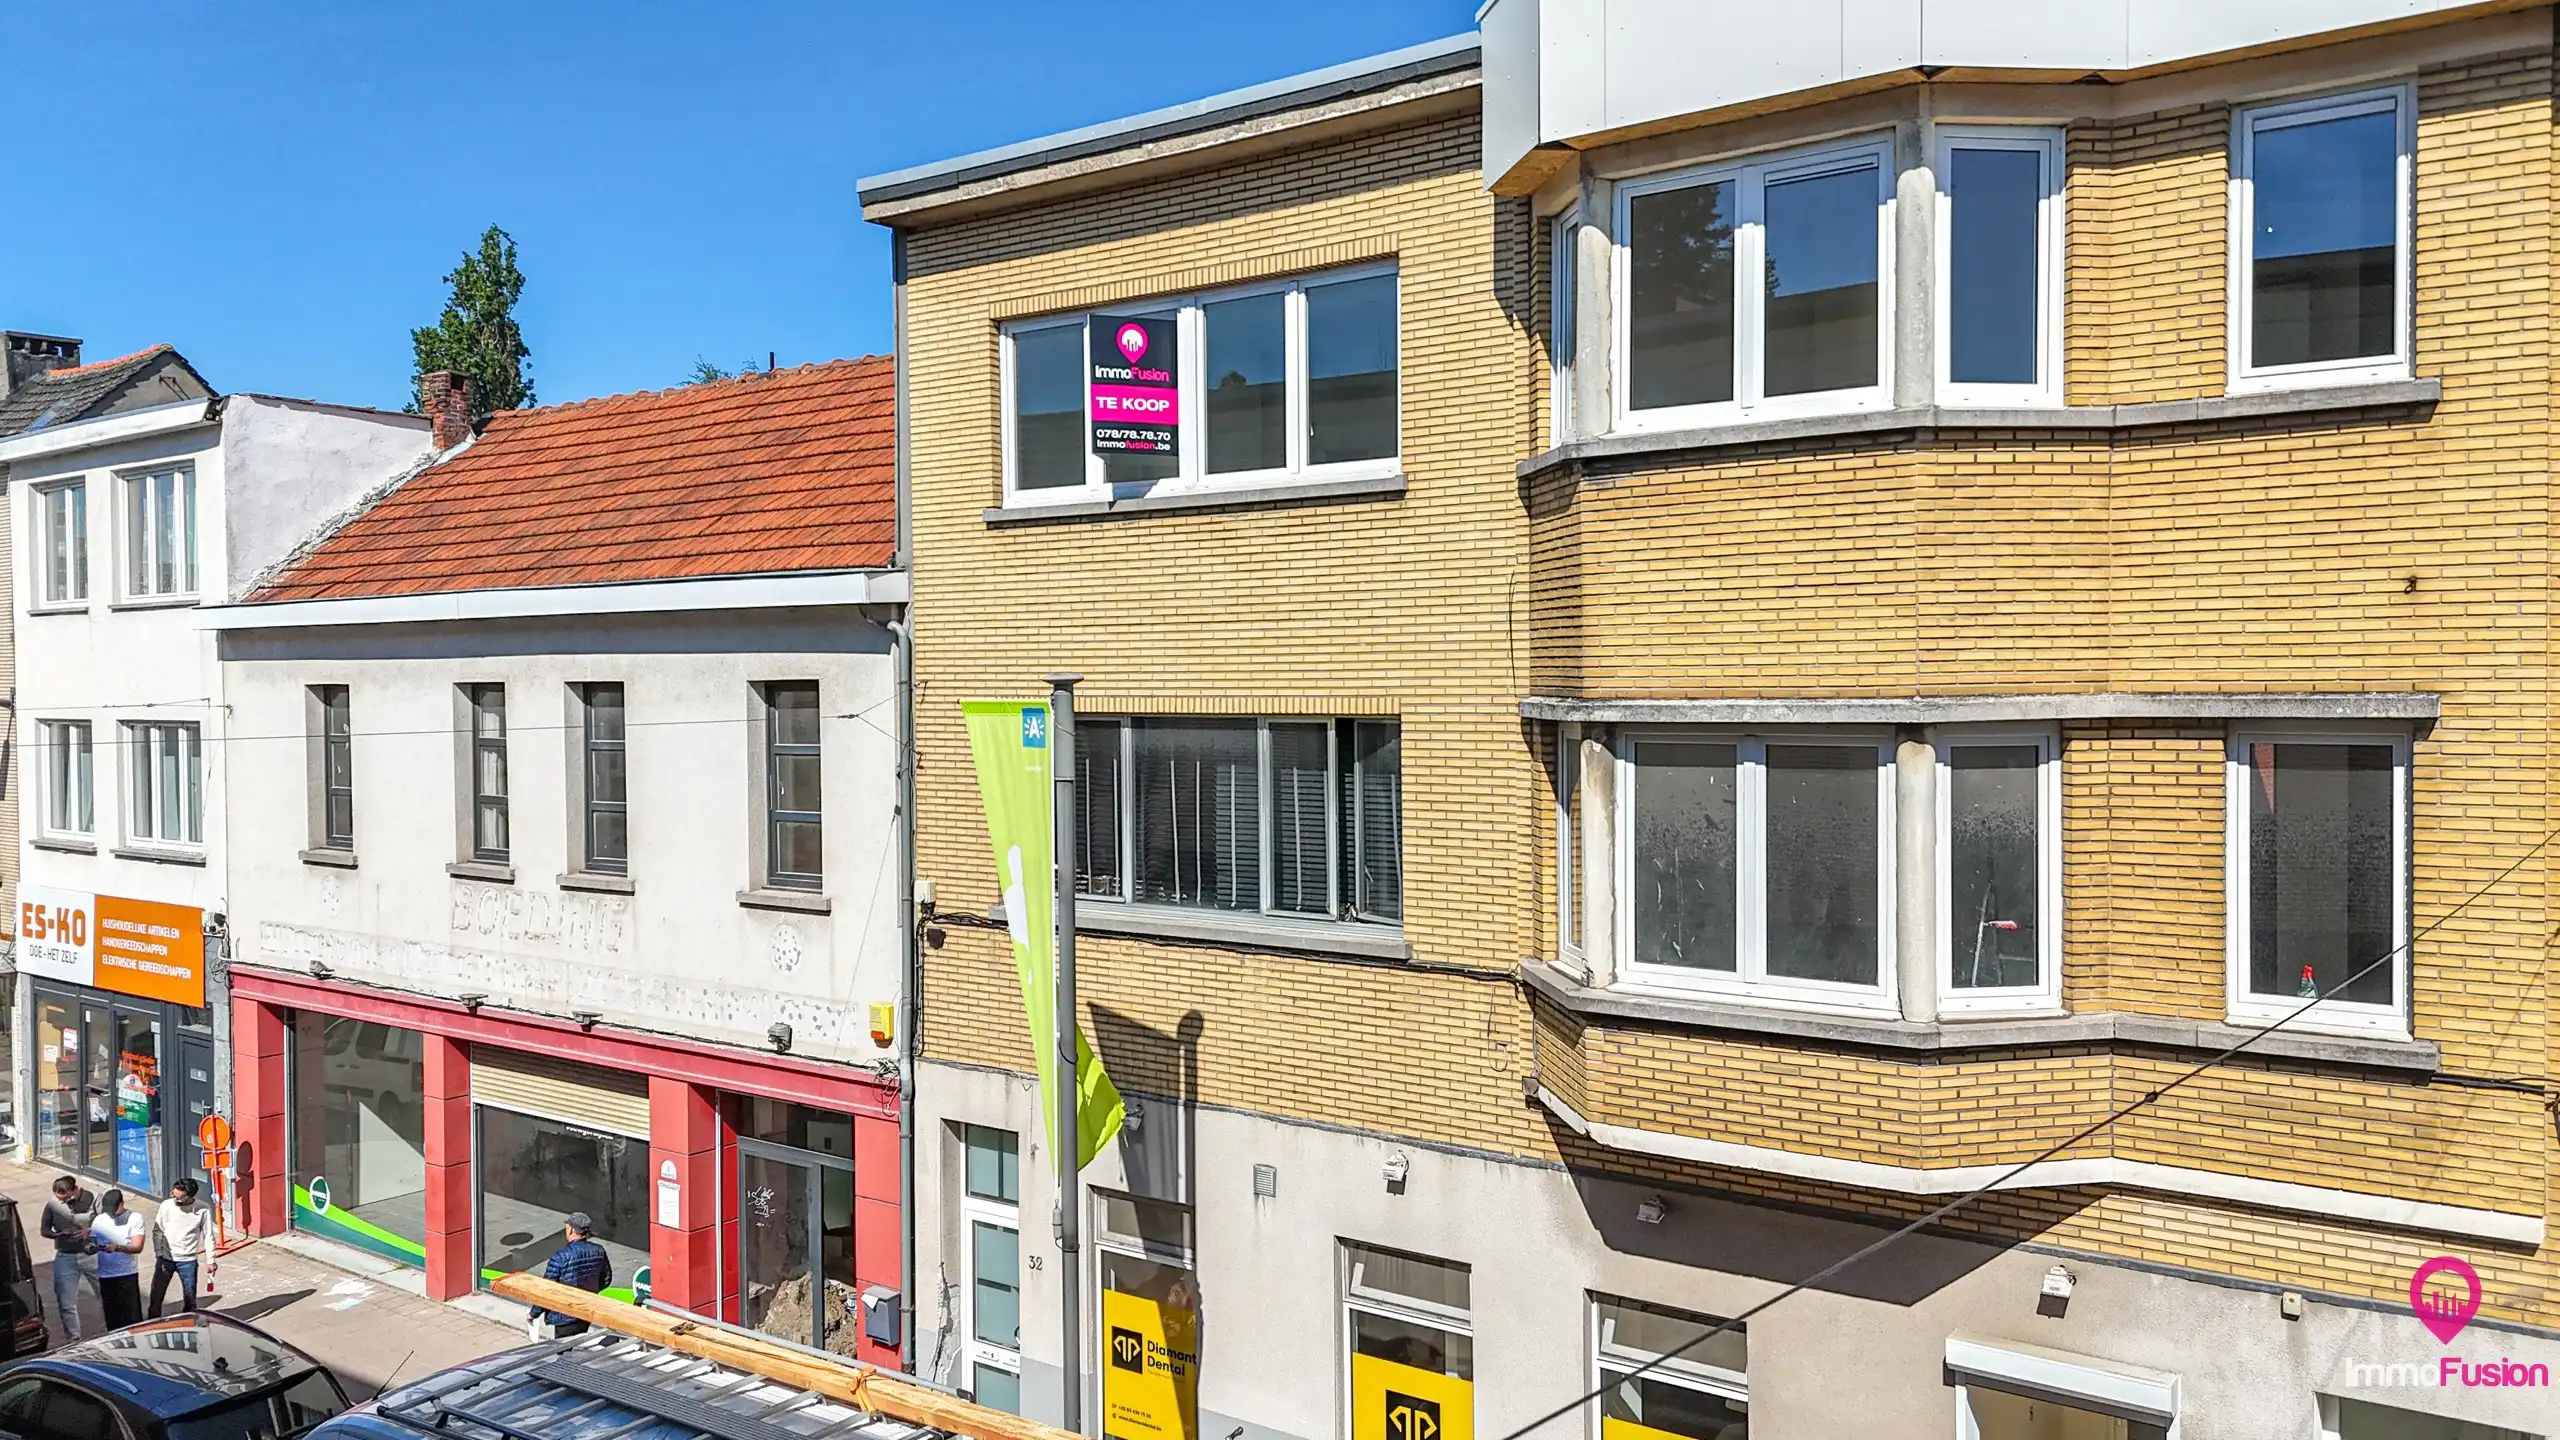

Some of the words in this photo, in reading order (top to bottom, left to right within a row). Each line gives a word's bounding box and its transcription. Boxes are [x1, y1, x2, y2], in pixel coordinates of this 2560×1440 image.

[1095, 365, 1170, 382] ImmoFusion
[1095, 397, 1118, 410] TE
[1122, 398, 1170, 412] KOOP
[1096, 429, 1171, 442] 078/78.78.70
[1096, 440, 1171, 451] immofusion.be
[22, 902, 86, 947] ES-KO
[148, 925, 180, 939] ARTIKELEN
[29, 944, 43, 959] DOE
[47, 948, 60, 961] HET
[61, 950, 78, 964] ZELF
[102, 954, 137, 970] ELEKTRISCHE
[138, 960, 191, 979] GEREEDSCHAPPEN
[1028, 1255, 1043, 1270] 32
[1147, 1340, 1197, 1365] Diamant
[1147, 1355, 1185, 1376] Dental
